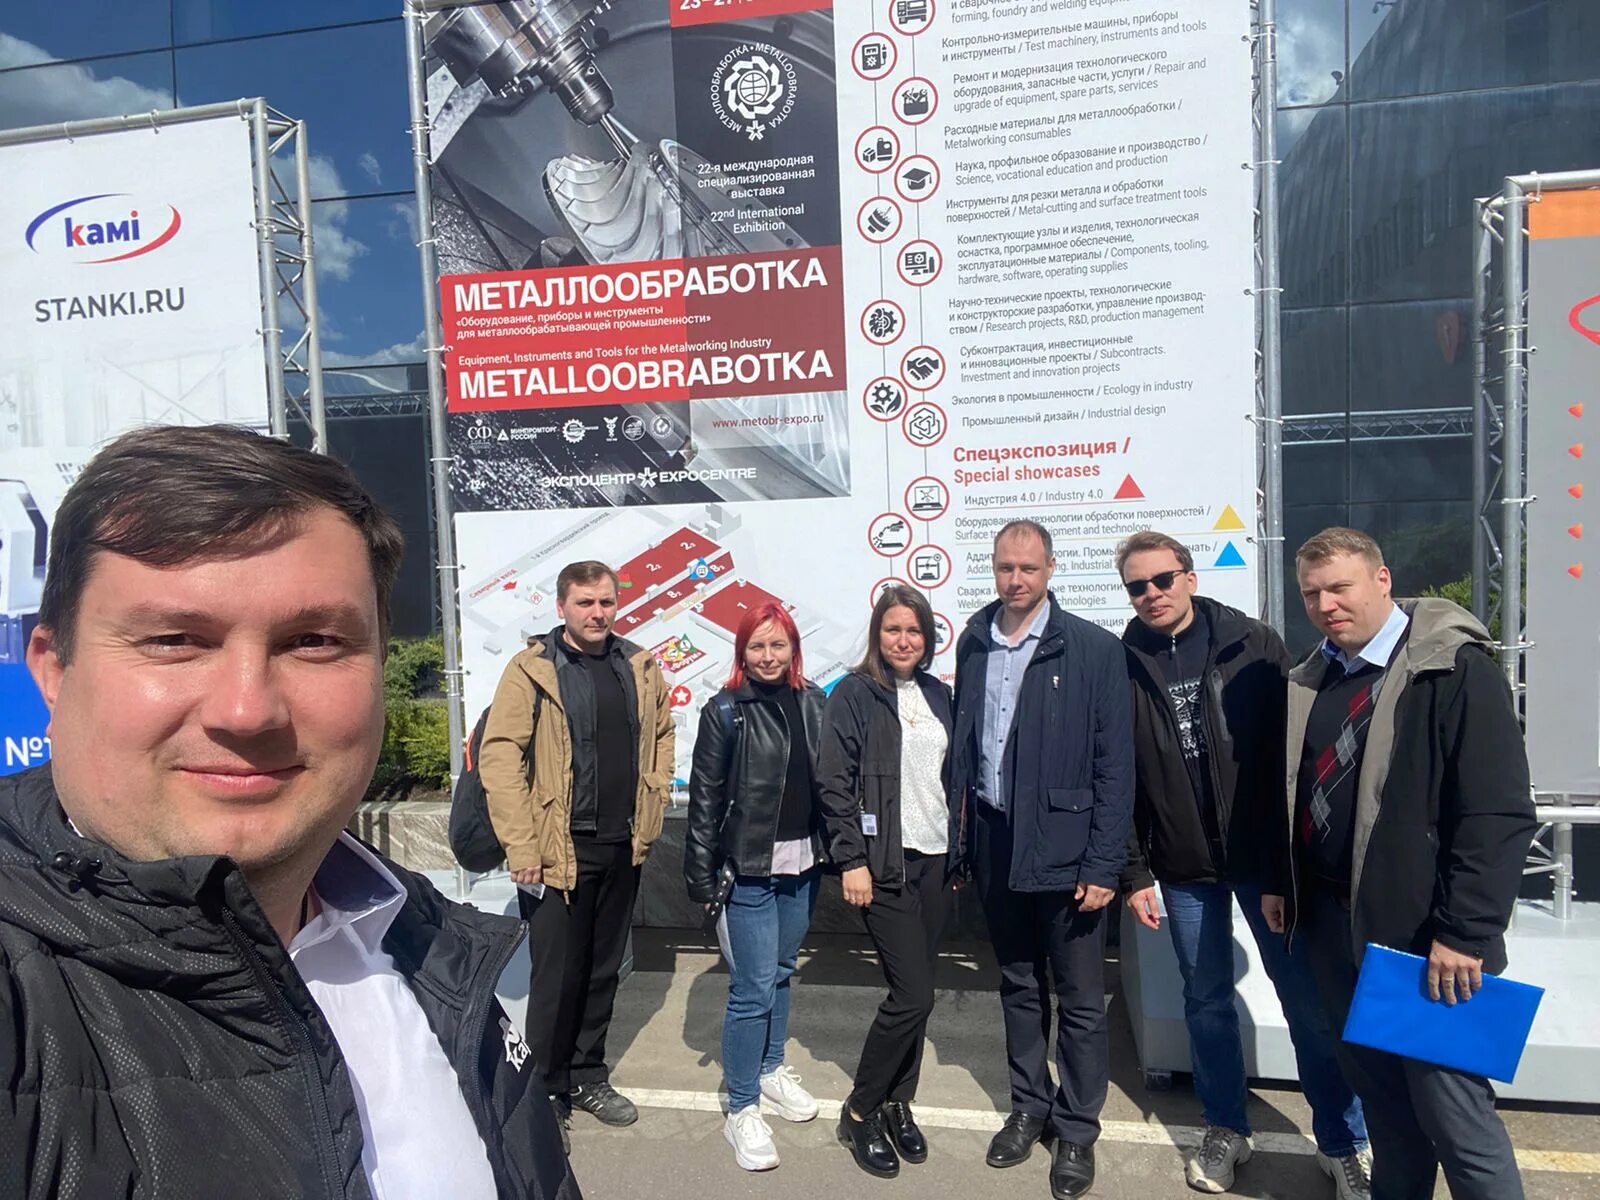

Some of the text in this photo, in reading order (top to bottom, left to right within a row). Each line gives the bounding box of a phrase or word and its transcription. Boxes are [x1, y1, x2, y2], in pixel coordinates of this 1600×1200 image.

[951, 13, 989, 23] forming,
[992, 5, 1028, 20] foundry
[1030, 2, 1047, 13] and
[1050, 0, 1087, 10] welding
[941, 11, 1178, 48] Контрольно-измерительные машины, приборы
[950, 20, 1206, 61] инструменты Test machinery, instruments and tools
[953, 50, 1167, 84] Ремонт модернизация технологического
[953, 57, 1206, 98] оборудования, запасные части, услуги Repair and
[711, 44, 749, 132] МЕТАЛЛООБРАБОТКА
[755, 42, 798, 128] METALLOOBRABOTKA
[953, 79, 1158, 113] upgrade equipment, spare parts, services
[944, 102, 1175, 136] Расходные материалы для металлообработки
[944, 126, 1071, 150] Metalworking consumables
[698, 155, 814, 174] 22-я международная
[955, 136, 1200, 173] Наука, профильное образование производство
[697, 168, 814, 188] специализированная
[955, 153, 1168, 185] Science, vocational education and production
[730, 185, 784, 200] выставка
[946, 178, 1163, 209] Инструменты для резки металла обработки
[946, 186, 1207, 223] поверхностей Metal-cutting and surface treatment tools
[710, 202, 804, 222] 22nd International
[733, 220, 785, 233] Exhibition
[957, 212, 1199, 244] Комплектующие узлы изделия, технологическая
[957, 233, 1134, 258] оснастка, программное обеспечение,
[957, 239, 1208, 272] эксплуатационные материалы Components, tooling,
[454, 257, 827, 312] МЕТАЛЛООБРАБОТКА
[958, 260, 1128, 285] hardware, software, operating supplies
[35, 287, 184, 322] STANKI.RU
[948, 280, 1172, 310] Научно-технические проекты, технологические
[956, 291, 1205, 321] конструкторские разработки, управление производ-
[456, 306, 663, 327] «Оборудование, приборы инструменты
[456, 314, 711, 340] для металлообрабатывающей промышленности»
[949, 304, 1204, 335] ством Research projects, R&D, production management
[458, 337, 771, 367] Equipment, Instruments and Tools for the Metalworking Industry
[960, 335, 1133, 358] Субконтрактация, инвестиционные
[968, 345, 1165, 368] инновационные проекты Subcontracts.
[459, 349, 833, 398] METALLOOBRABOTKA
[960, 362, 1120, 382] Investment and innovation projects
[951, 380, 1193, 405] Экология промышленности Ecology industry
[712, 413, 823, 428] www.metobr-expo.ru
[962, 404, 1166, 428] Промышленный дизайн Industrial design
[468, 426, 492, 440] СФ
[953, 441, 1116, 463] Спецэкспозиция
[541, 474, 636, 488] ЭКСПОЦЕНТР
[660, 468, 757, 483] EXPOCENTRE
[954, 464, 1100, 486] Special showcases
[964, 488, 1103, 506] Индустрия 4.0 Industry 4.0
[1085, 511, 1134, 523] обработки
[1137, 507, 1204, 520] поверхностей
[956, 530, 988, 540] Surface
[1083, 524, 1100, 534] and
[1102, 522, 1152, 534] technology
[1071, 559, 1112, 570] Industrial
[957, 586, 991, 598] Сварка
[1068, 584, 1122, 592] технологии
